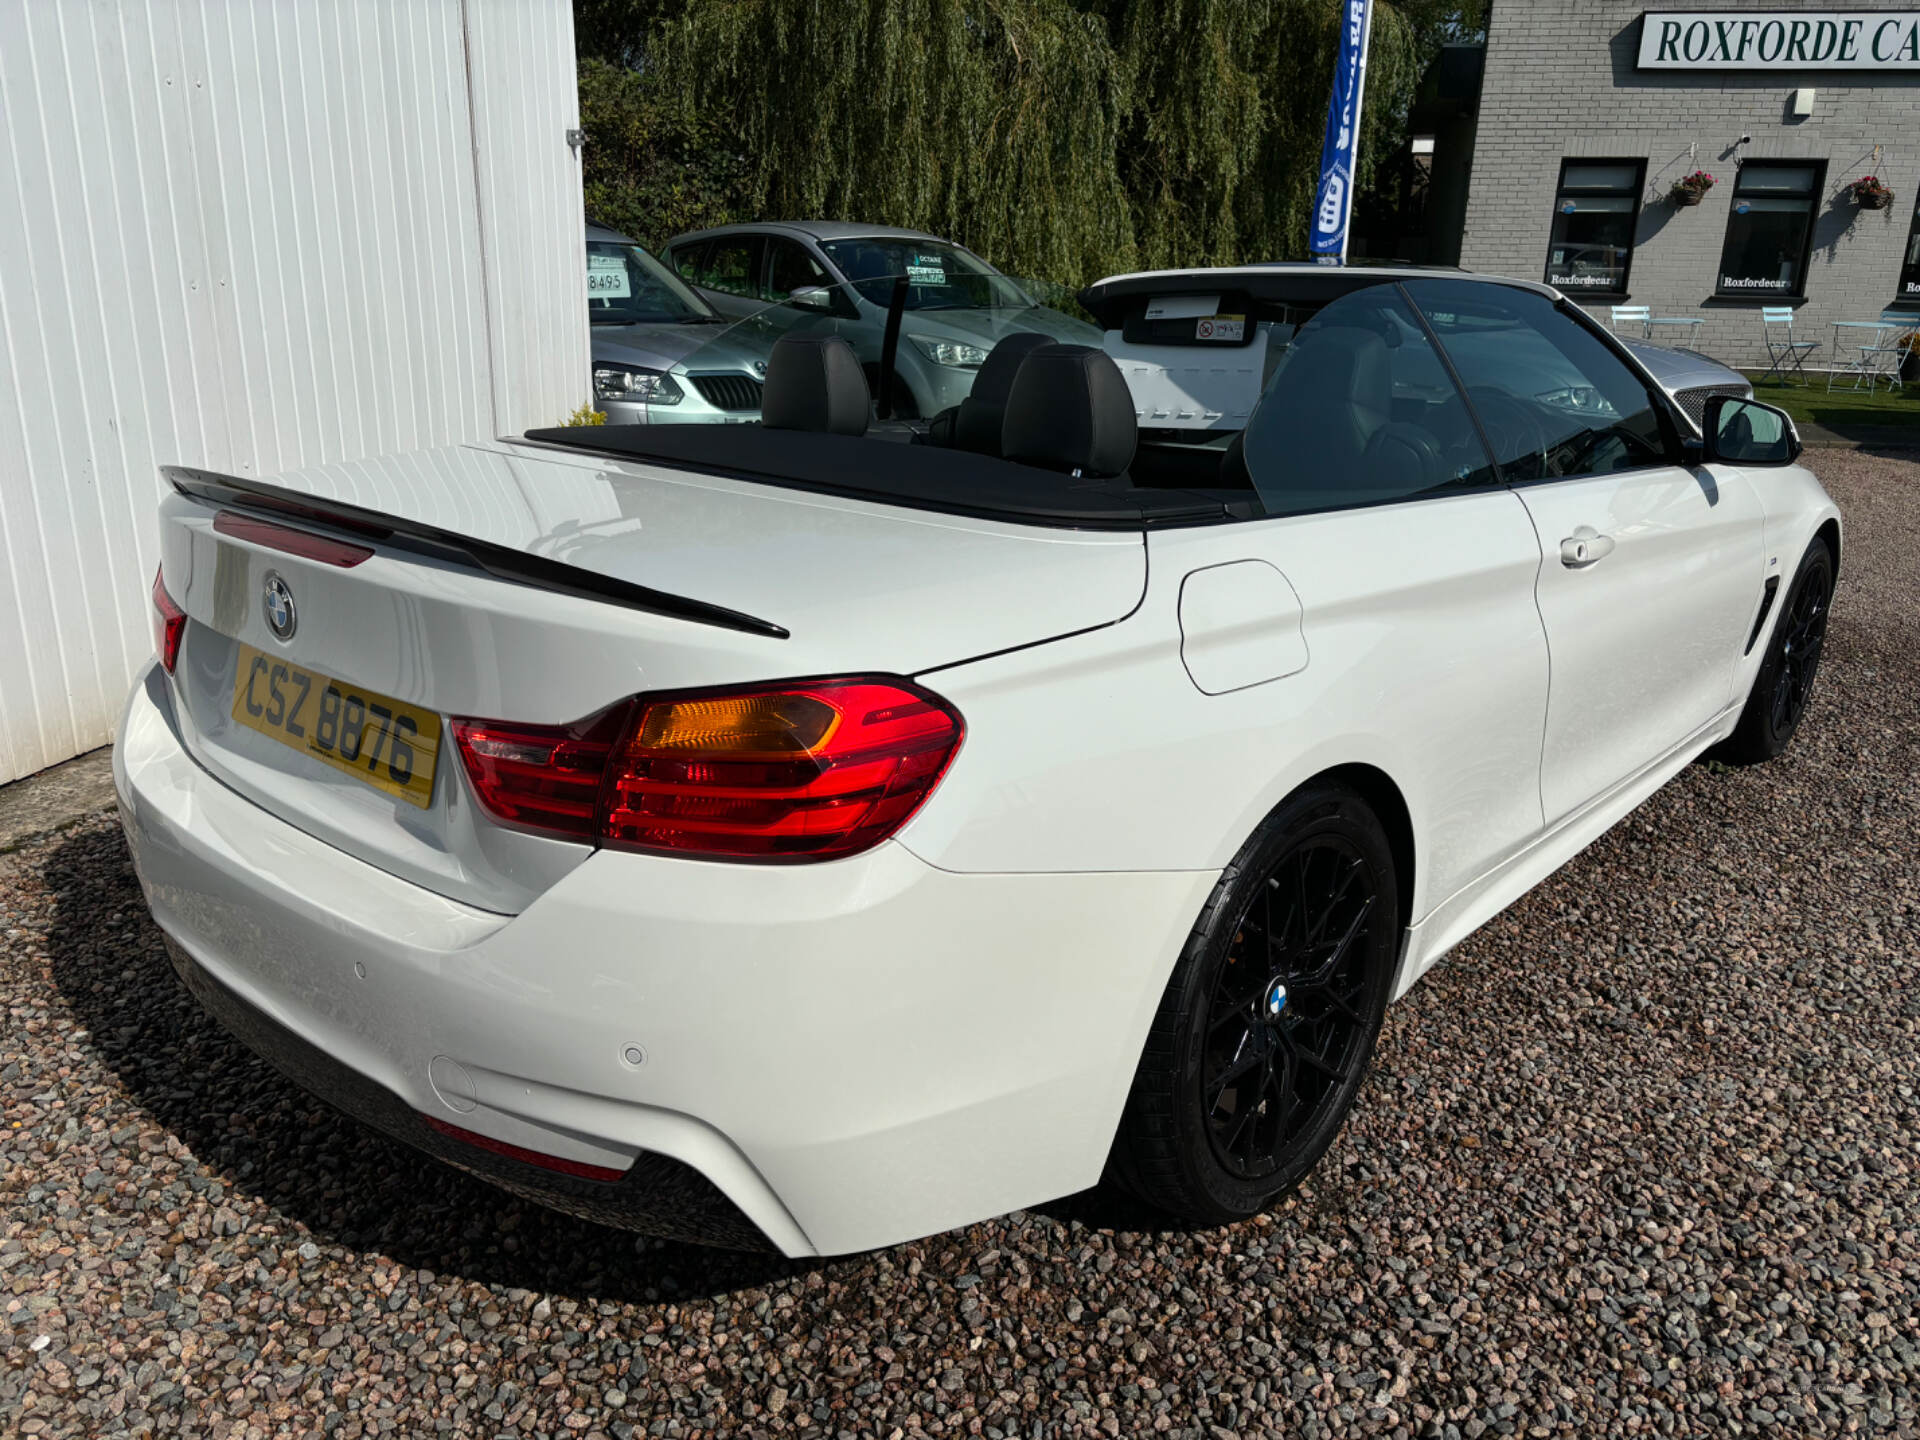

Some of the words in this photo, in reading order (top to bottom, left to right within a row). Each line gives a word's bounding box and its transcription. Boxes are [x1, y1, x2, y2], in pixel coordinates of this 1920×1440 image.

[1655, 19, 1863, 62] ROXFORDE
[1871, 19, 1920, 62] CA
[589, 274, 621, 289] 8495
[245, 656, 311, 739] CSZ
[315, 684, 418, 785] 8876
